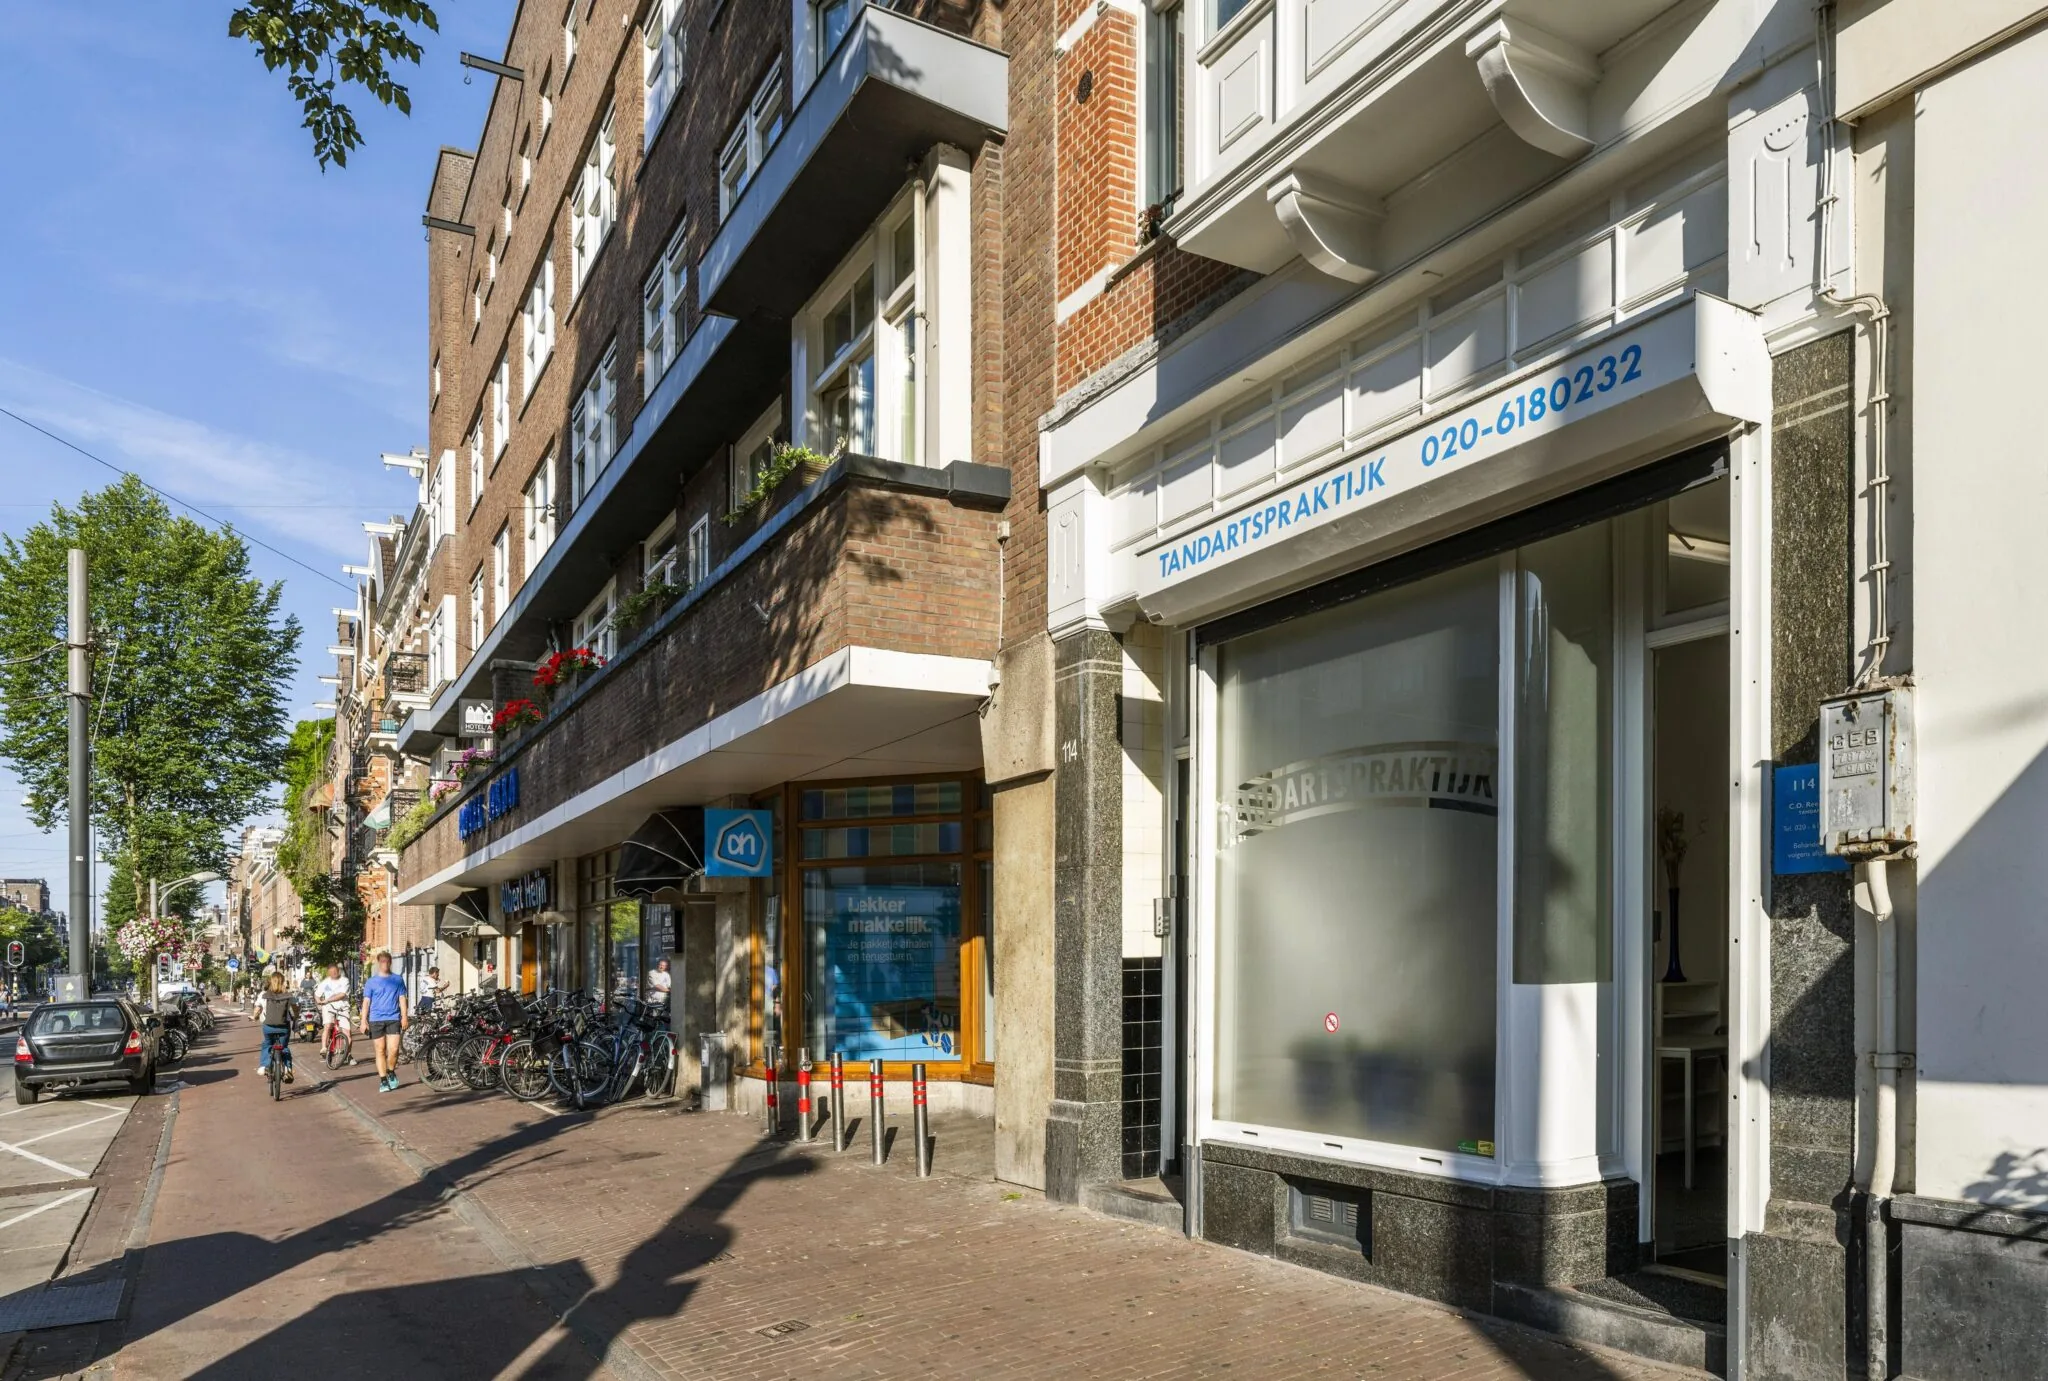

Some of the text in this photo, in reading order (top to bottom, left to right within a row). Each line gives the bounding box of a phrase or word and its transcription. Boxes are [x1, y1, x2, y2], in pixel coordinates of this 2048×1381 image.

[1159, 344, 1643, 579] TANDARTSPRAKTIJK 020-6180232
[1833, 729, 1878, 750] GEB
[1062, 739, 1077, 763] 114
[1793, 778, 1815, 791] 114
[501, 869, 547, 913] Albert Heijn
[848, 896, 906, 913] Lekker
[848, 915, 932, 935] makkelijk.
[848, 953, 859, 962] en
